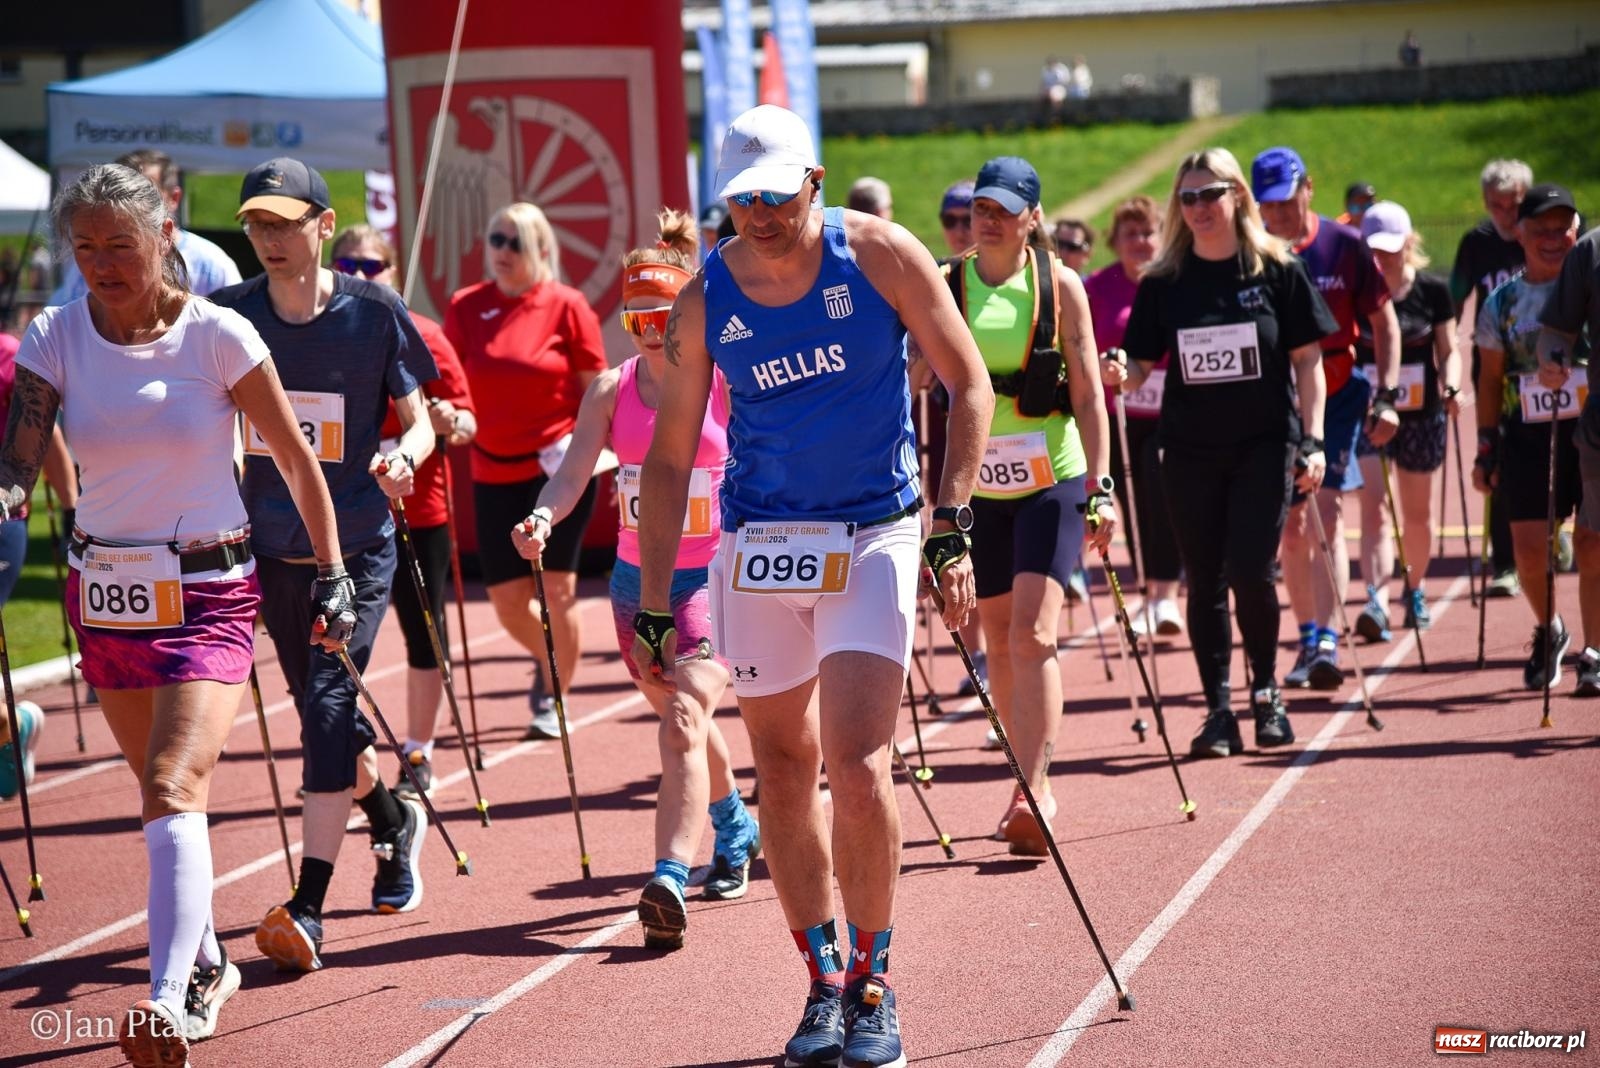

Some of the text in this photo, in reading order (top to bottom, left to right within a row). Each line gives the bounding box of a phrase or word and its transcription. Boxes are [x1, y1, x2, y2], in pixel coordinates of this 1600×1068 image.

[628, 271, 675, 284] LEKI
[719, 329, 753, 344] adidas
[752, 344, 846, 390] HELLAS
[1191, 350, 1236, 373] 252
[1532, 389, 1571, 412] 100
[979, 462, 1029, 485] 085
[744, 535, 788, 544] 3MAJA2026
[745, 526, 830, 536] XVIII BIEG BEZ GRANIC
[122, 552, 153, 563] GRANIC
[746, 554, 818, 582] 096
[89, 582, 150, 614] 086
[647, 624, 659, 647] LEKI
